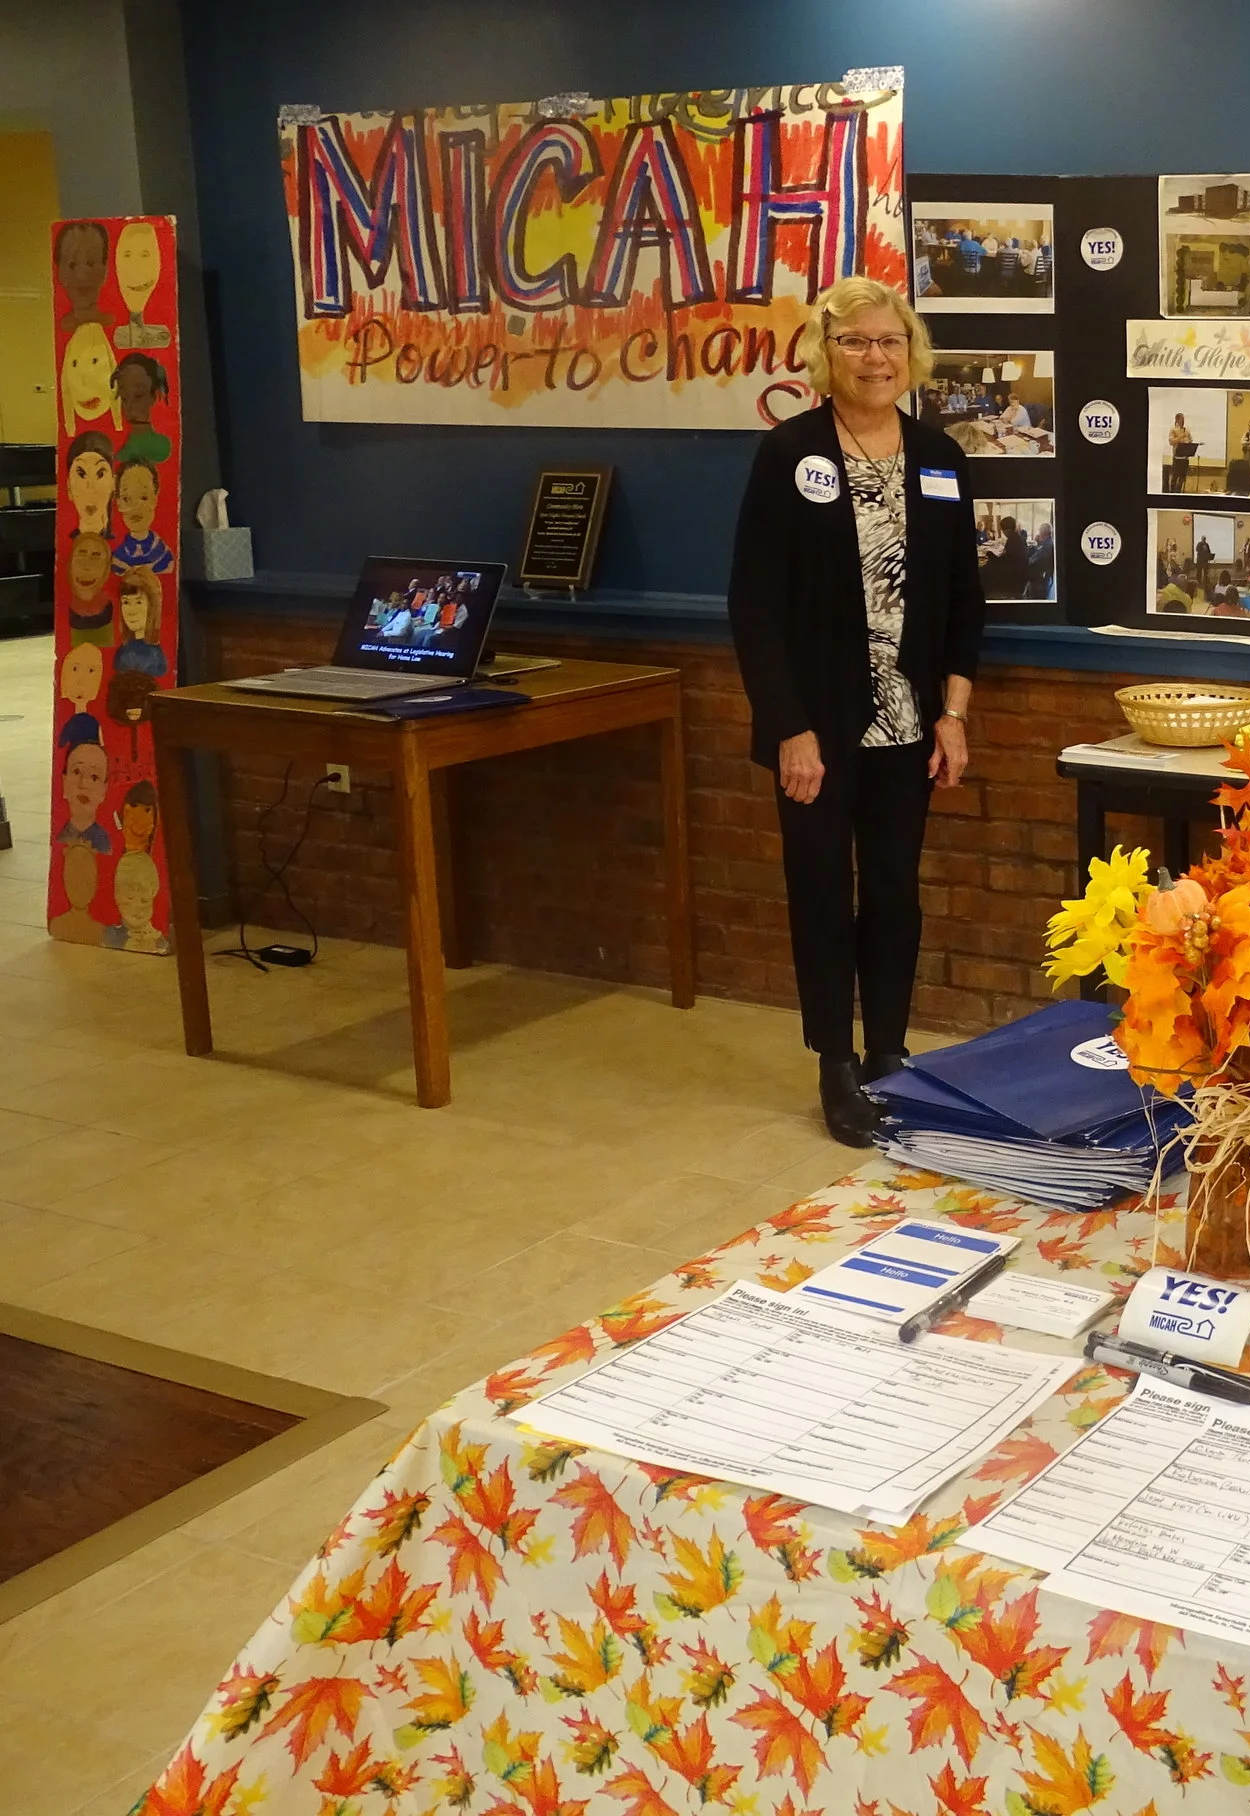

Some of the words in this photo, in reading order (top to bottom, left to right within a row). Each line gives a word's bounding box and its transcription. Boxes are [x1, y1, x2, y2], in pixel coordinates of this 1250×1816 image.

[301, 106, 867, 319] MICAH
[1088, 241, 1115, 254] YES!
[1132, 344, 1185, 368] Faith
[1194, 344, 1246, 377] Hope
[1086, 416, 1112, 428] YES!
[805, 468, 836, 489] YES!
[1088, 537, 1114, 549] YES!
[934, 1233, 961, 1244] Hello
[880, 1266, 909, 1278] Hello
[733, 1289, 768, 1308] Please
[769, 1299, 792, 1314] sign
[792, 1302, 809, 1316] in!
[1159, 1275, 1239, 1315] YES!
[1149, 1314, 1176, 1333] MICAH
[1140, 1388, 1182, 1406] Please
[1184, 1396, 1211, 1414] sign
